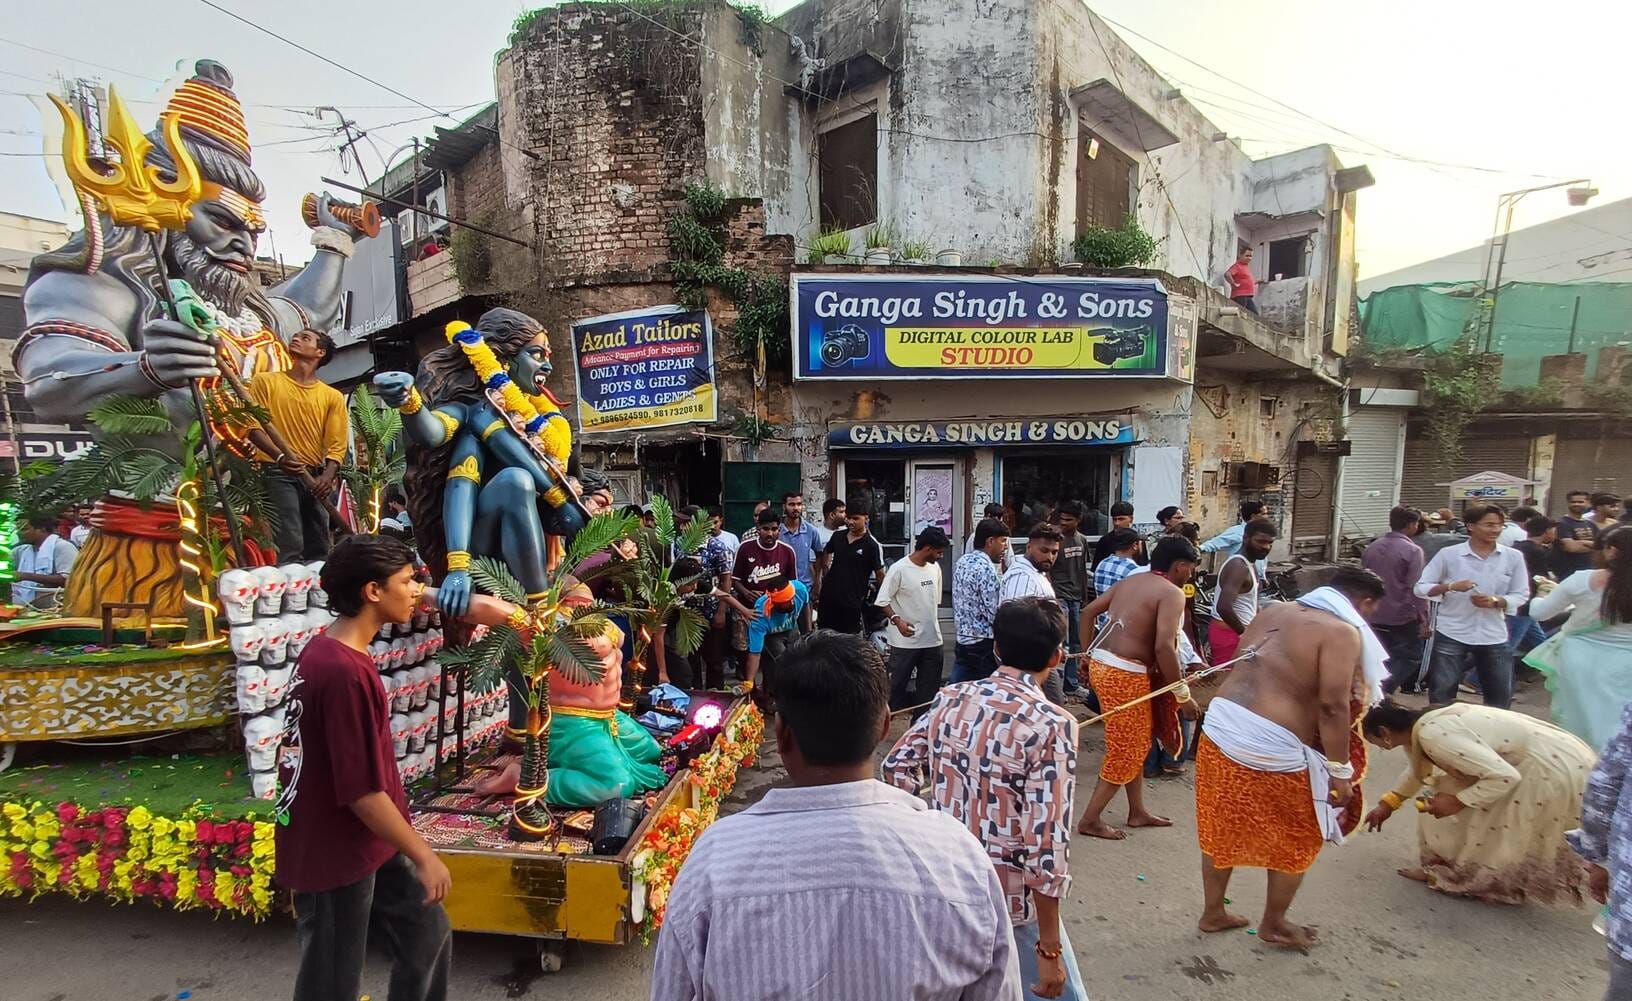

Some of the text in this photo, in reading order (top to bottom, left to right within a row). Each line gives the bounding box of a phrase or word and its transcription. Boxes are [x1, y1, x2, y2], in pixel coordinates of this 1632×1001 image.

[814, 290, 923, 325] Ganga
[933, 290, 1028, 325] Singh
[1036, 291, 1068, 318] &
[1078, 292, 1154, 319] Sons
[581, 319, 701, 352] Azad Tailors
[898, 331, 1074, 345] DIGITAL COLOUR LAB
[615, 349, 646, 362] Payment
[646, 347, 660, 358] for
[940, 347, 1034, 366] STUDIO
[590, 357, 695, 380] ONLY FOR REPAIR
[600, 374, 687, 395] BOYS & GIRLS
[594, 389, 697, 411] LADIES & GENTS
[849, 420, 1121, 445] GANGA SINGH & SONS
